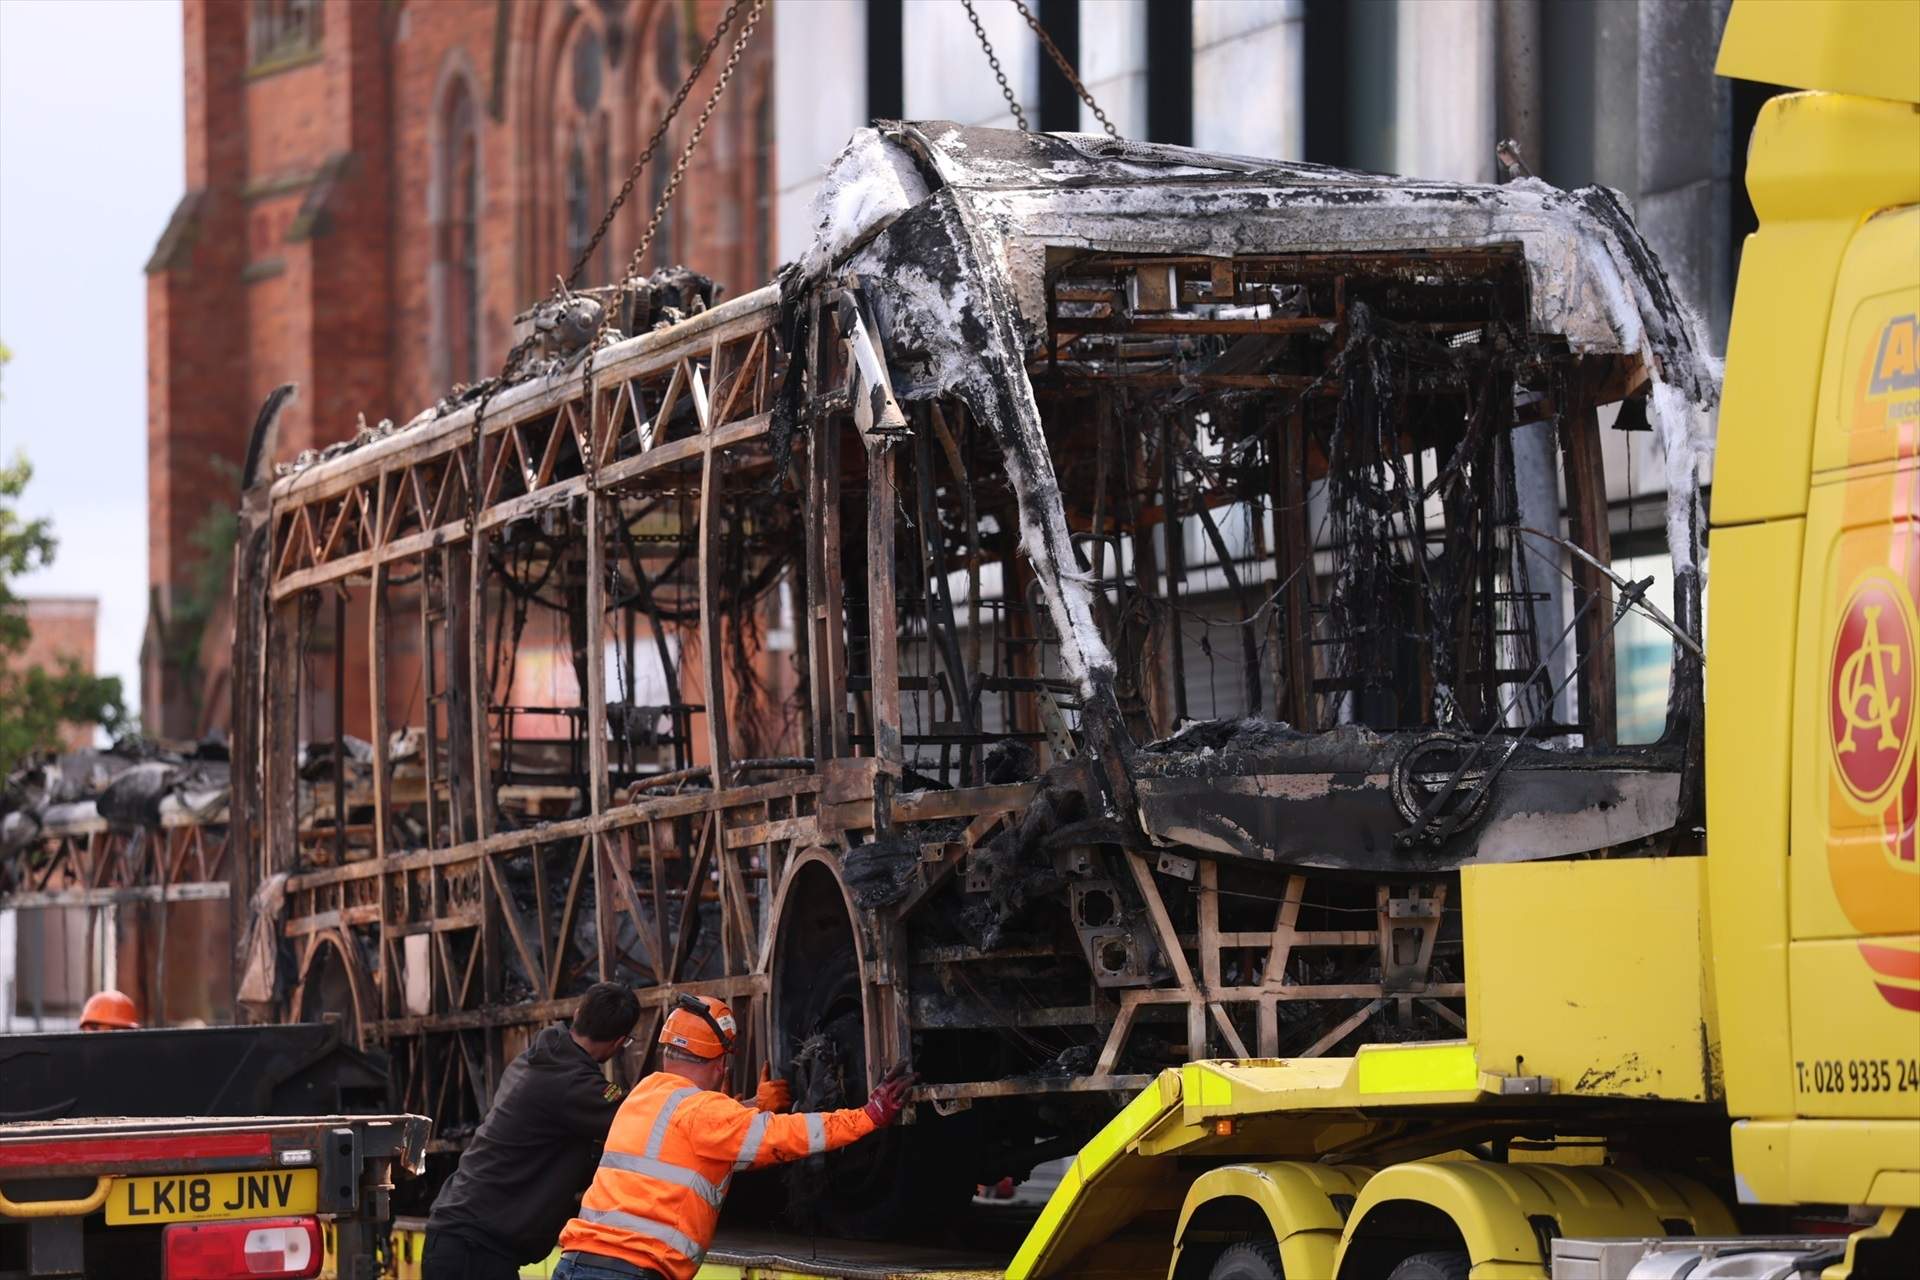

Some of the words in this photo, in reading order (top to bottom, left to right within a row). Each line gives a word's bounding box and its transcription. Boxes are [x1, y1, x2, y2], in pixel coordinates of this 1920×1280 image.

[1868, 314, 1920, 395] A
[1796, 1061, 1810, 1093] T:
[1815, 1061, 1844, 1093] 028
[1849, 1060, 1891, 1093] 9335
[1897, 1060, 1920, 1092] 24
[128, 1179, 210, 1216] LK18
[224, 1174, 293, 1210] JNV
